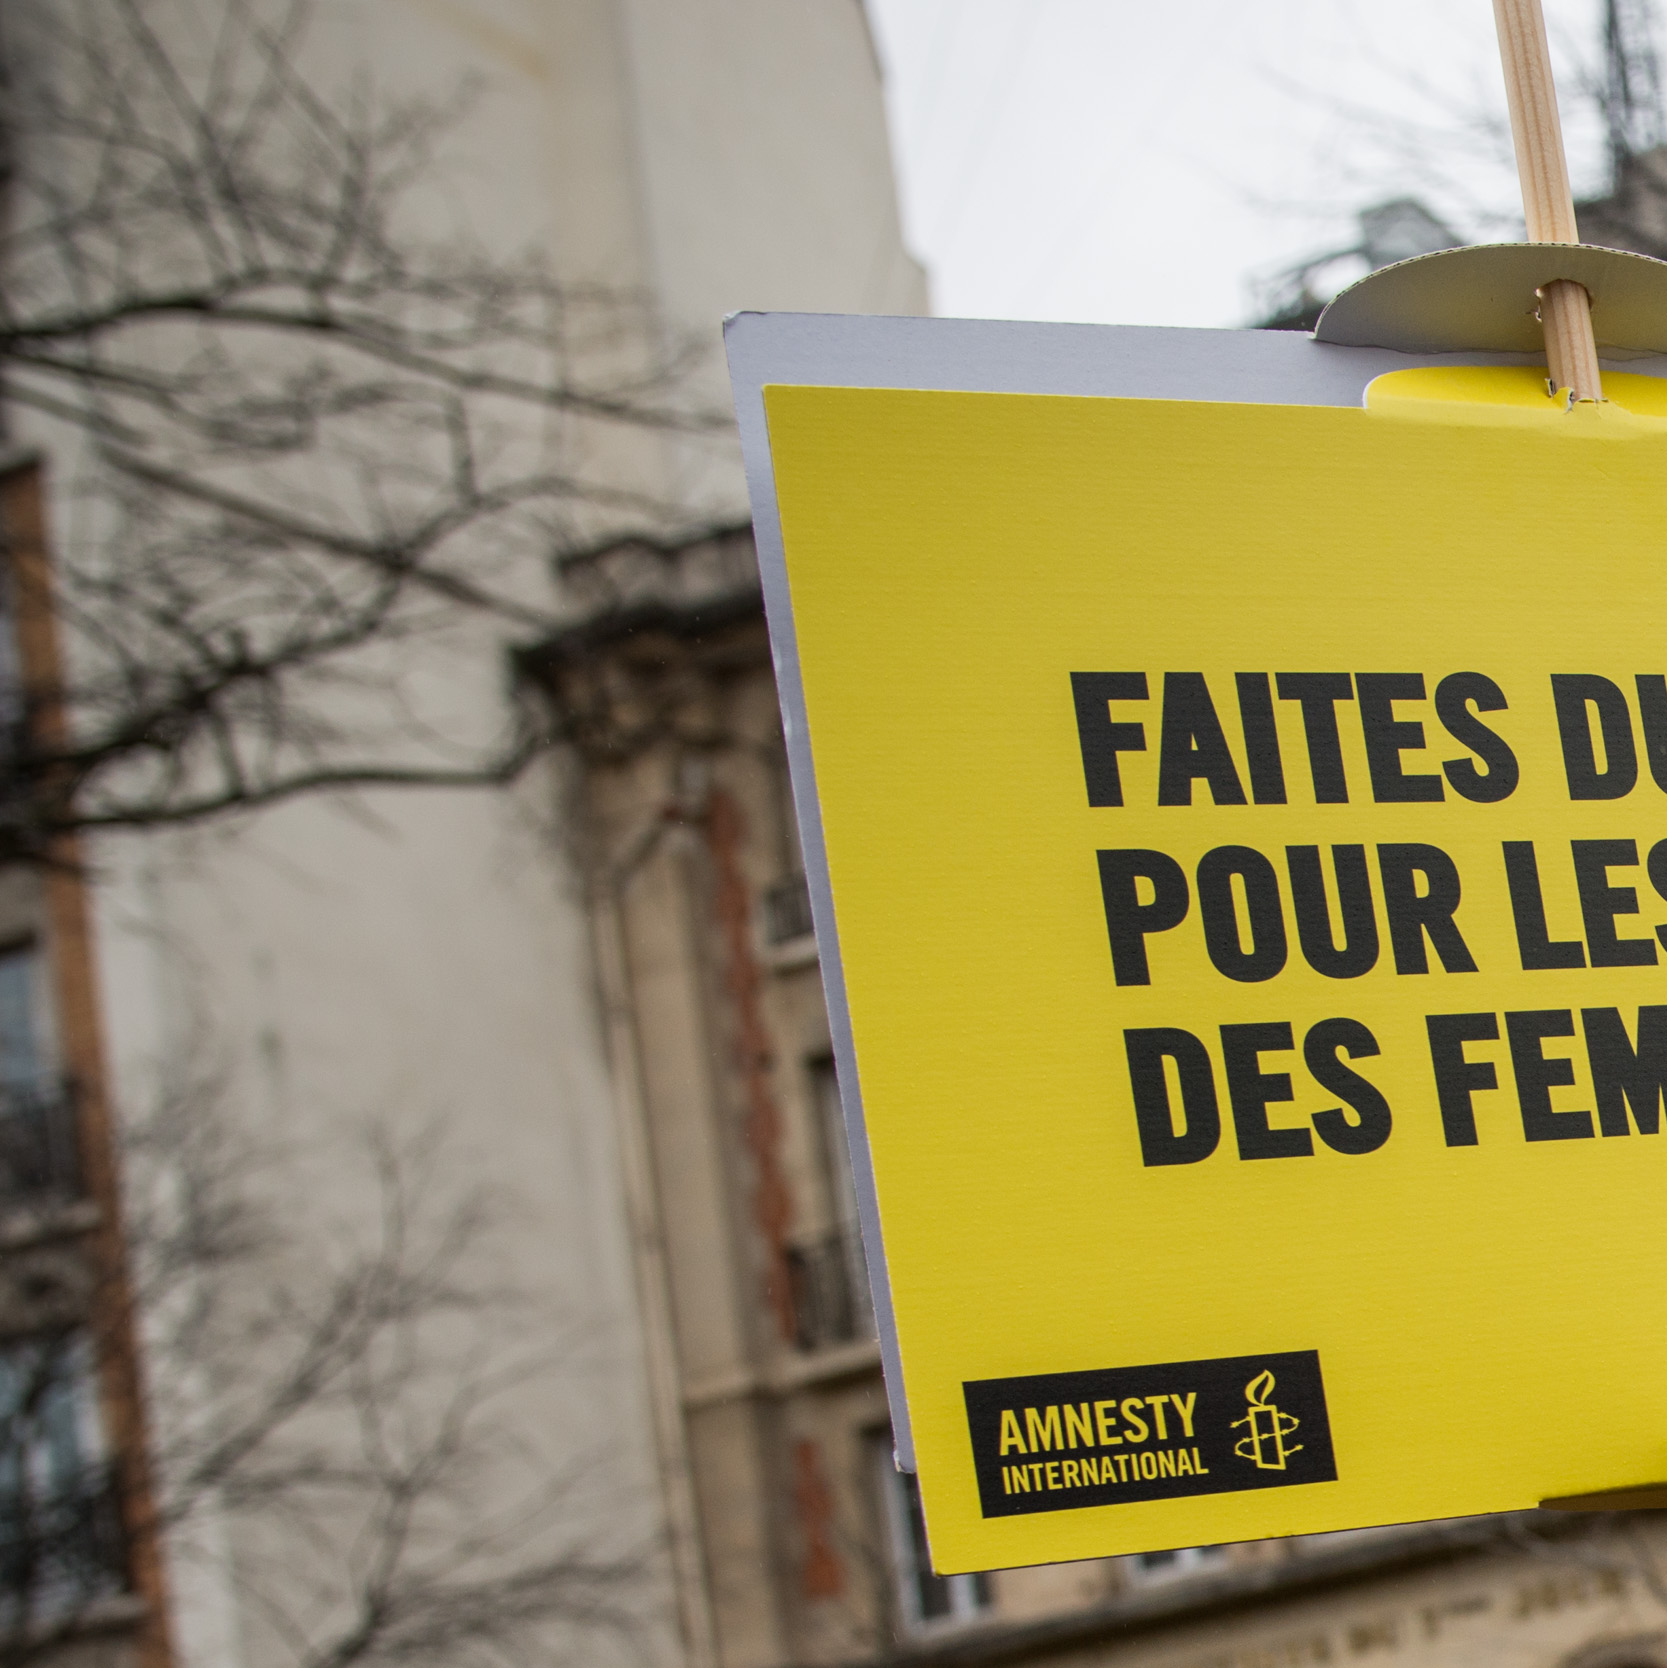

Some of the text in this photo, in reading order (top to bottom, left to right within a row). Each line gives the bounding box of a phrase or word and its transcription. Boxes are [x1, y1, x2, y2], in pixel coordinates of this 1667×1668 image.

[1070, 671, 1520, 808] FAITES
[1095, 842, 1479, 987] POUR
[1122, 1017, 1393, 1168] DES
[1000, 1391, 1197, 1456] AMNESTY
[1002, 1447, 1209, 1495] INTERNATIONAL
